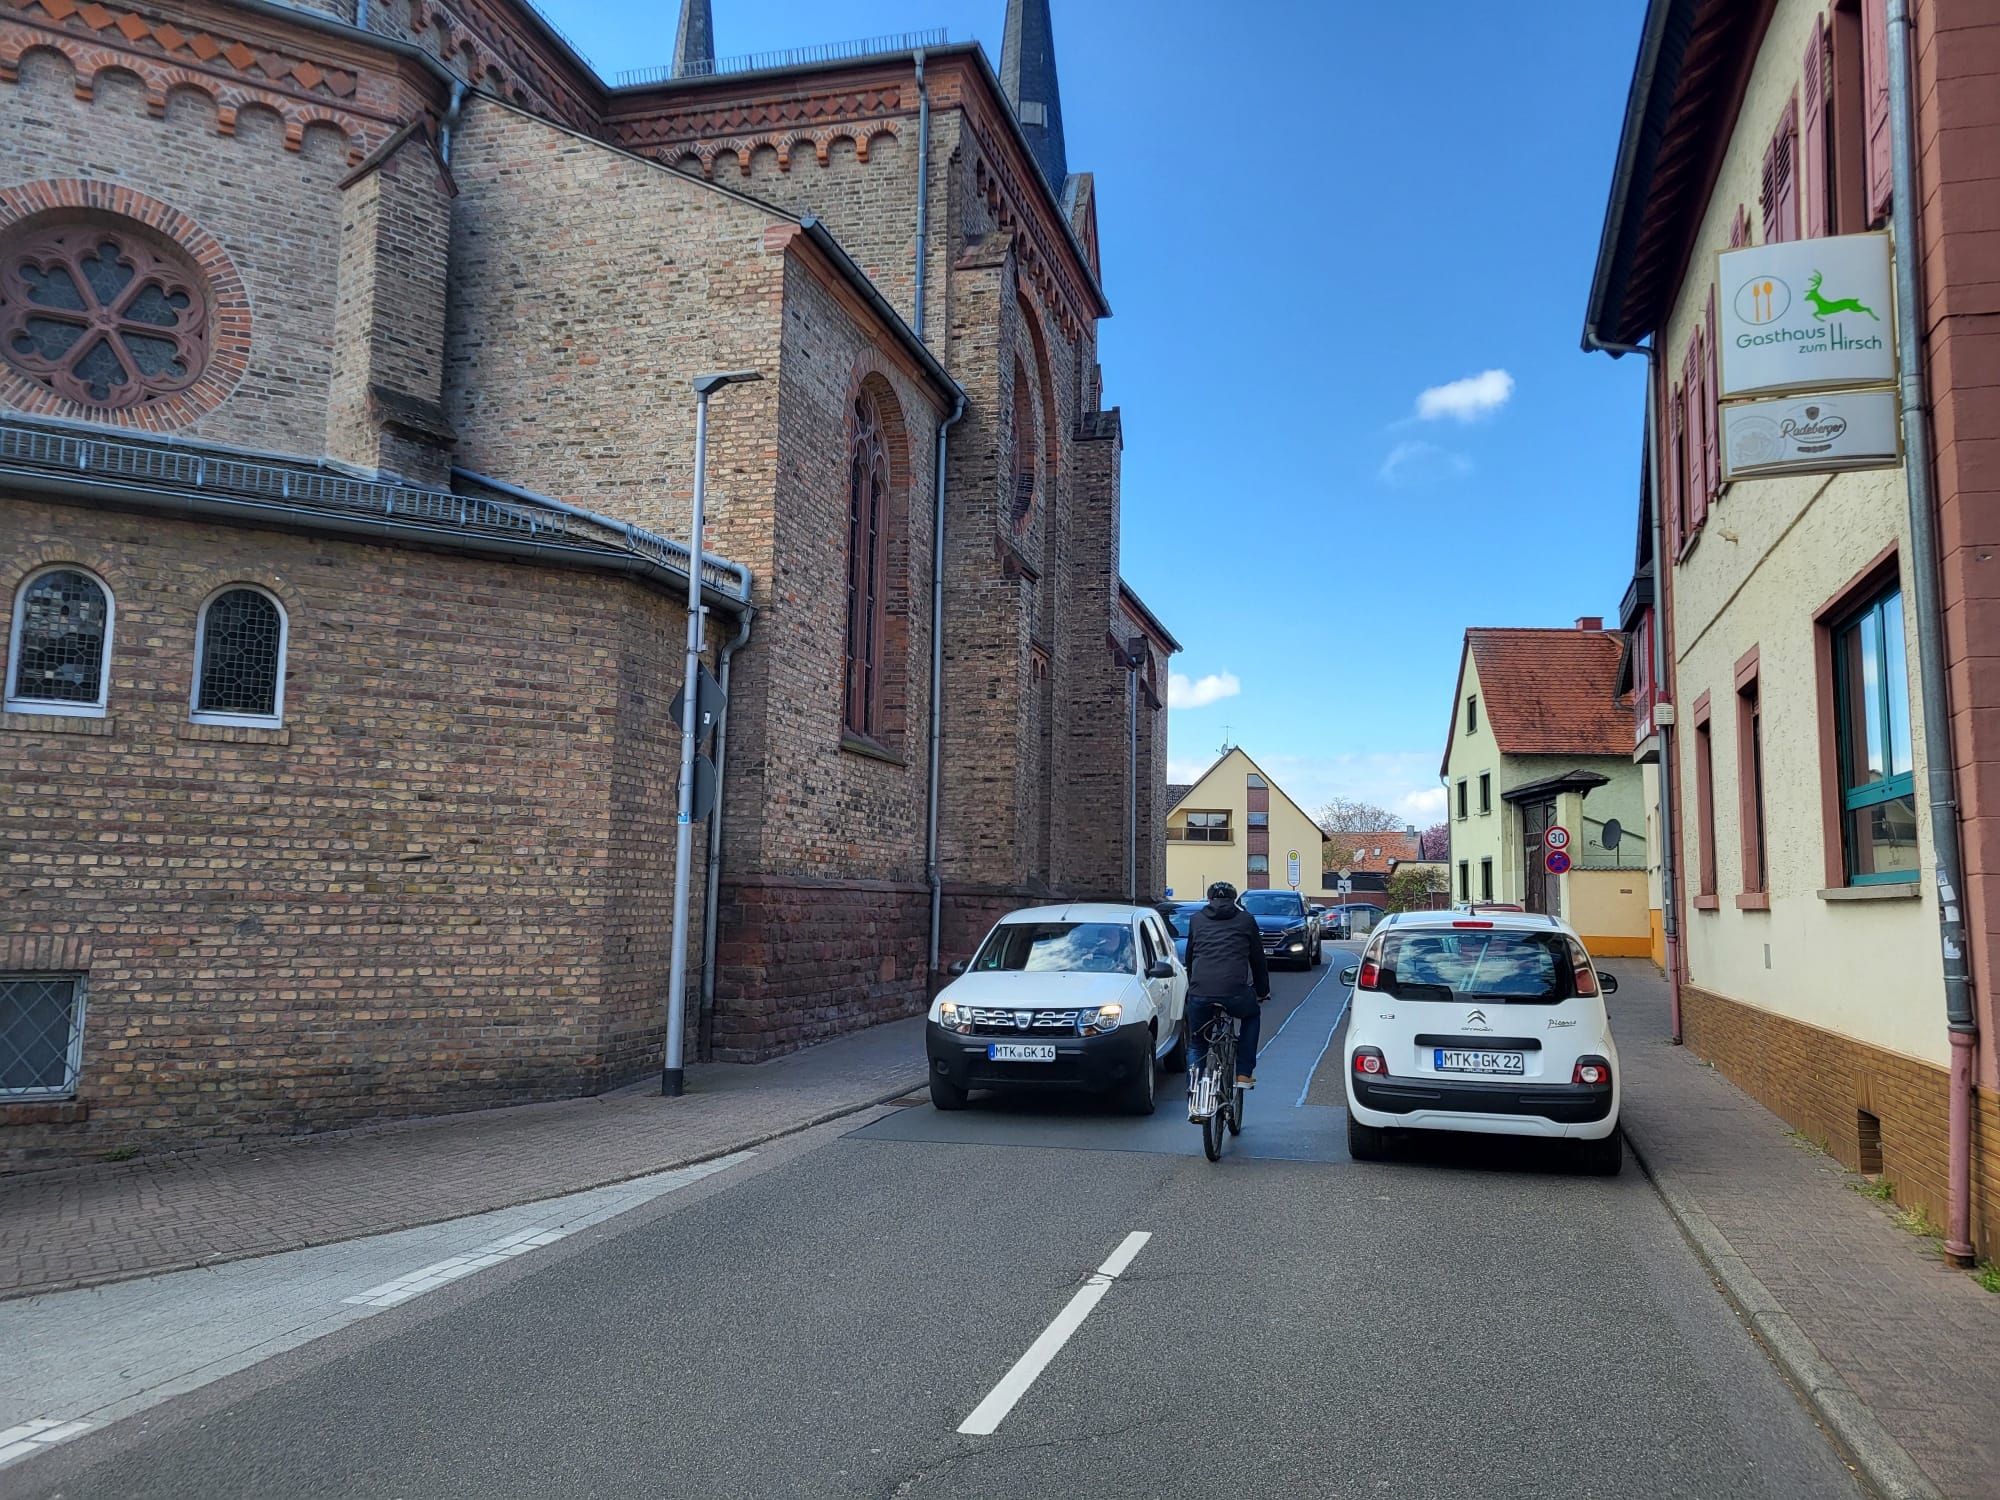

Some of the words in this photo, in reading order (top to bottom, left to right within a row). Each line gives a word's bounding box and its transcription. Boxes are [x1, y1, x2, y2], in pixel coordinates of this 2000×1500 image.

[1736, 327, 1826, 349] Gasthaus
[1798, 343, 1828, 354] zum
[1830, 322, 1883, 351] Hirsch
[1779, 416, 1846, 439] Radeberger
[1550, 832, 1565, 844] 30
[995, 1046, 1017, 1058] MTK
[1023, 1046, 1038, 1059] GK
[1040, 1047, 1054, 1059] 16
[1444, 1052, 1472, 1067] MTK
[1481, 1053, 1500, 1068] GK
[1503, 1055, 1522, 1069] 22
